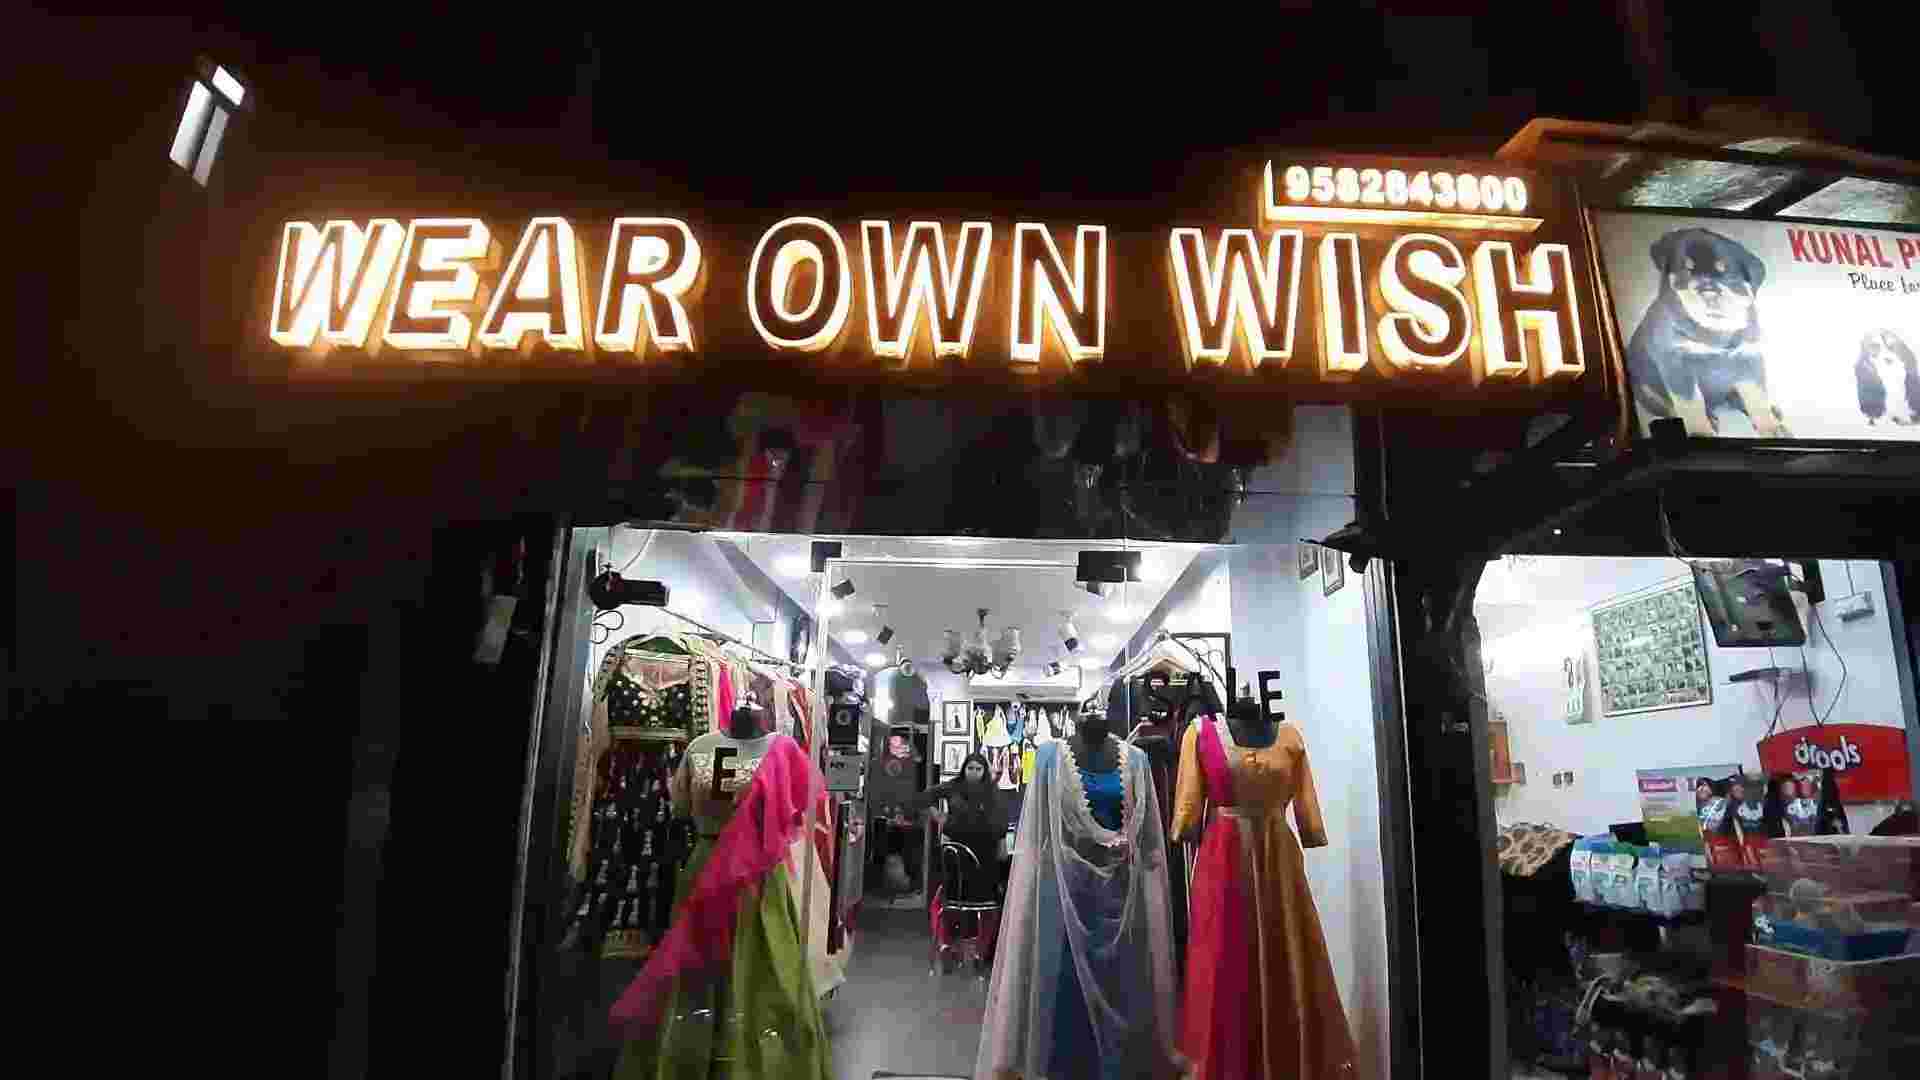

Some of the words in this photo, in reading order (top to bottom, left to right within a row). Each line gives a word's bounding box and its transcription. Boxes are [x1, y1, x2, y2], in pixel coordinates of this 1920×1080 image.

[1787, 227, 1893, 268] KUNAL
[269, 216, 701, 352] WEAR
[747, 216, 1107, 362] OWN
[1170, 228, 1587, 376] WISH
[1794, 736, 1862, 771] drools
